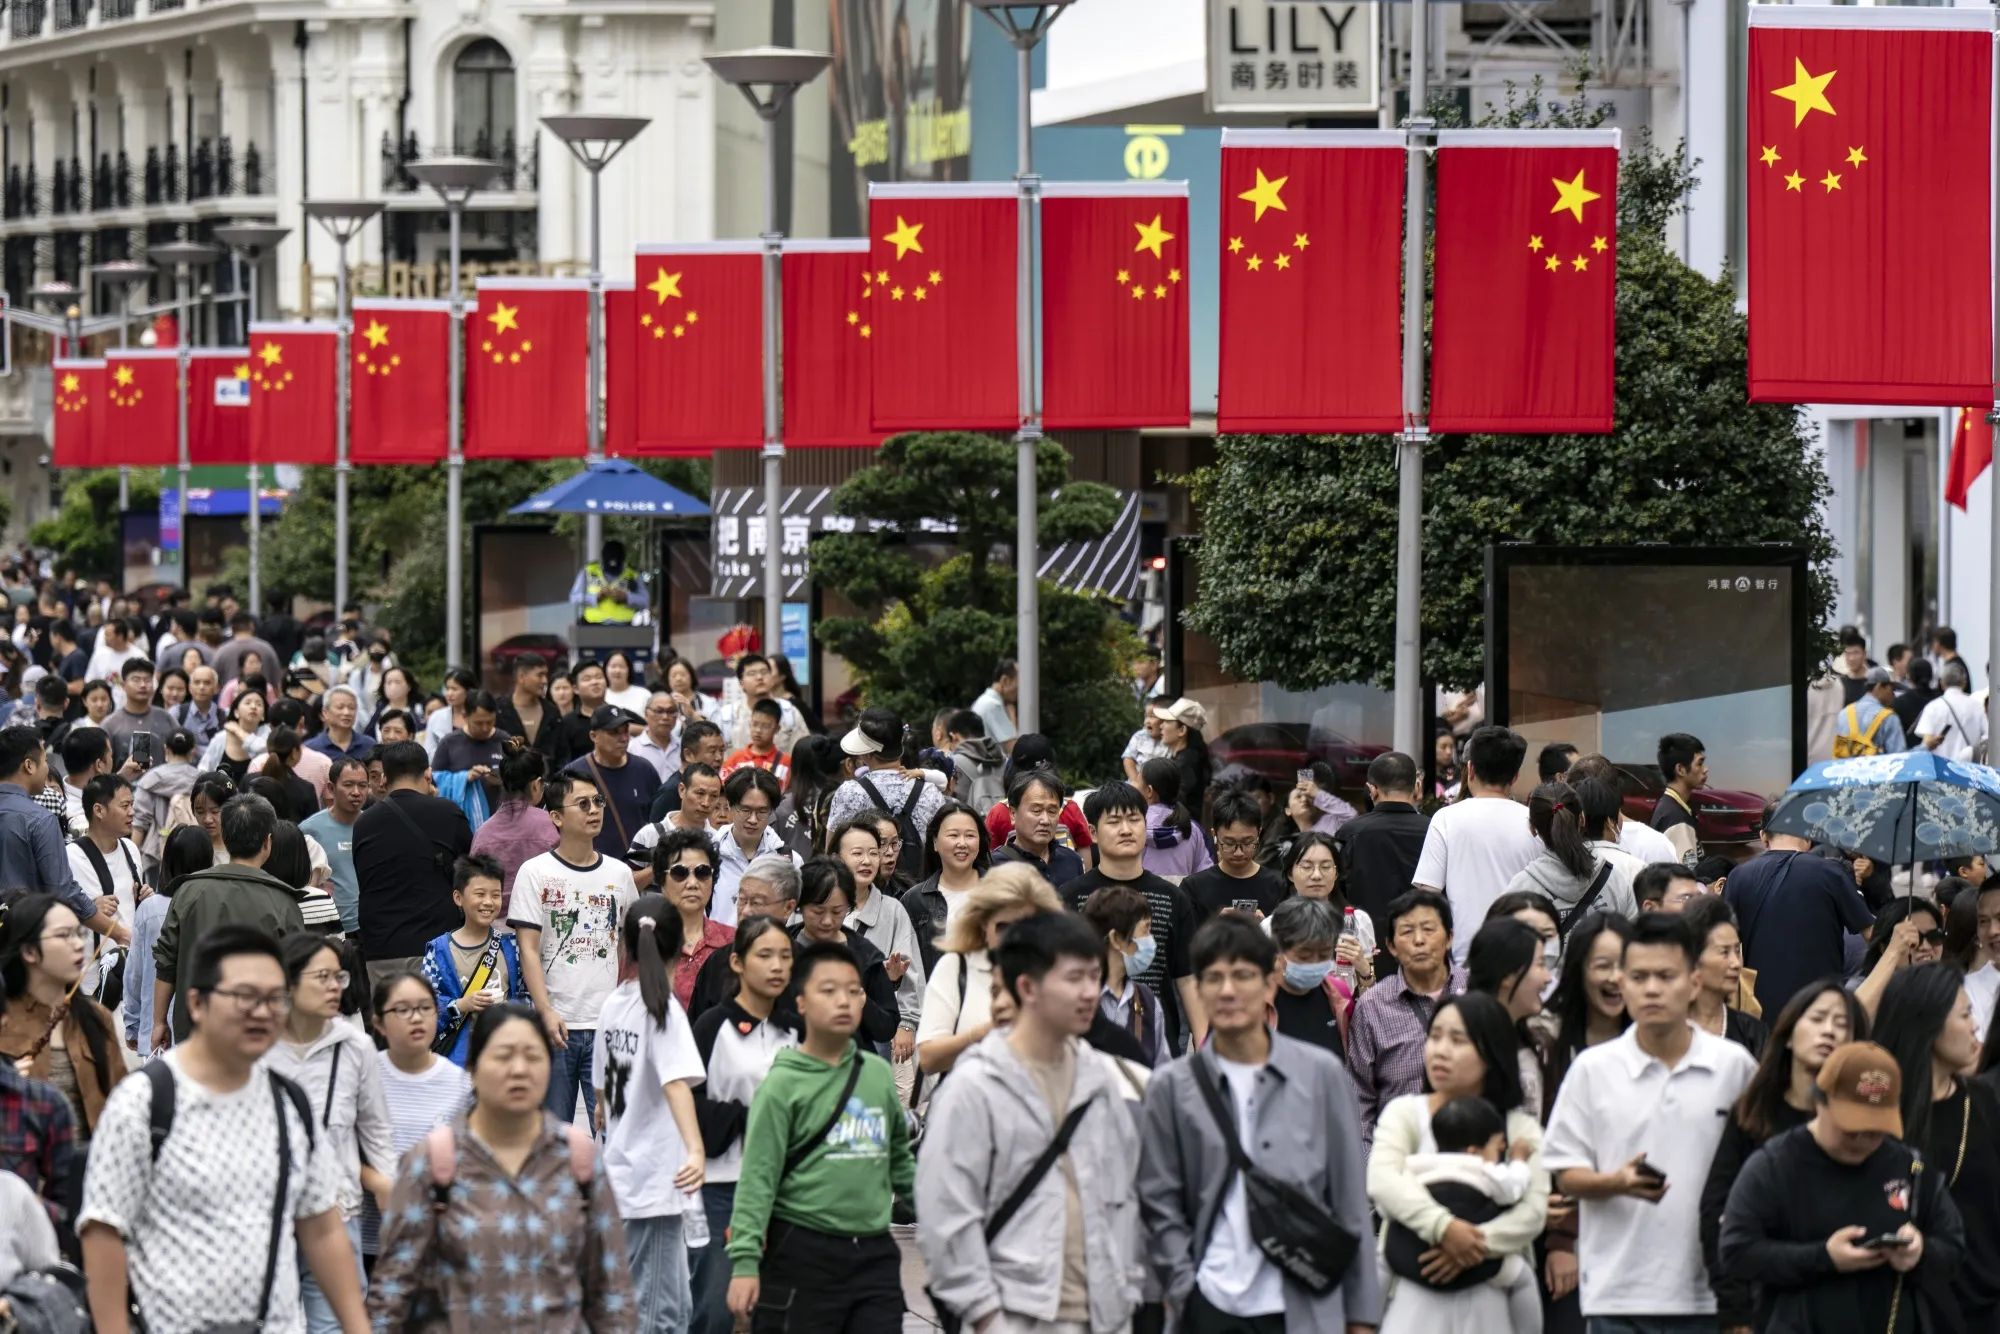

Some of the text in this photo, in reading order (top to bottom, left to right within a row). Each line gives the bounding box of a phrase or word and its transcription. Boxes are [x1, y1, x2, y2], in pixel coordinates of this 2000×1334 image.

[1230, 6, 1356, 54] LILY
[1230, 60, 1359, 91] 商务时装
[603, 500, 656, 511] POLICE
[1707, 579, 1778, 590] 鸿蒙 智行
